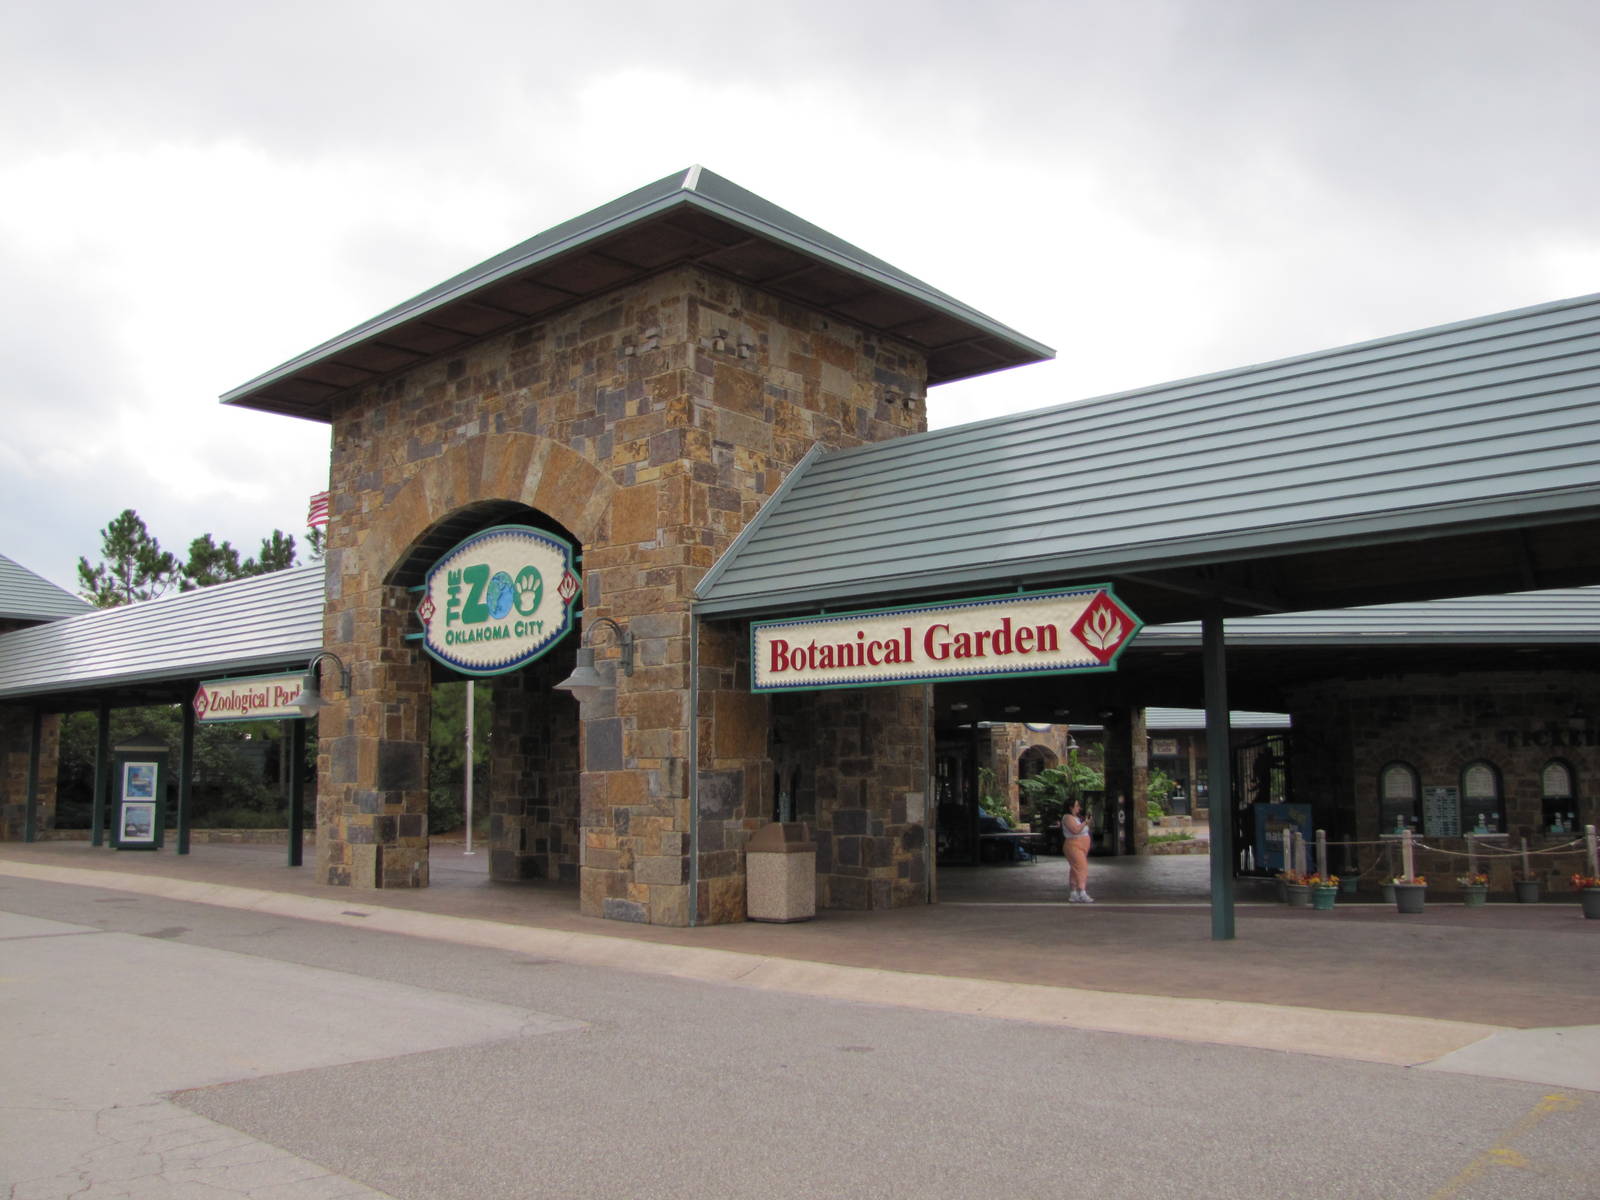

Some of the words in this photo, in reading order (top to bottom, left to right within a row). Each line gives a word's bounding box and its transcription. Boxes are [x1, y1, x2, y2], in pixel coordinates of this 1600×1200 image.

[447, 569, 462, 626] THE
[446, 625, 510, 645] OKLAHOMA
[514, 620, 544, 637] CITY
[769, 627, 914, 673] Botanical
[923, 617, 1060, 660] Garden
[210, 687, 269, 714] Zoological
